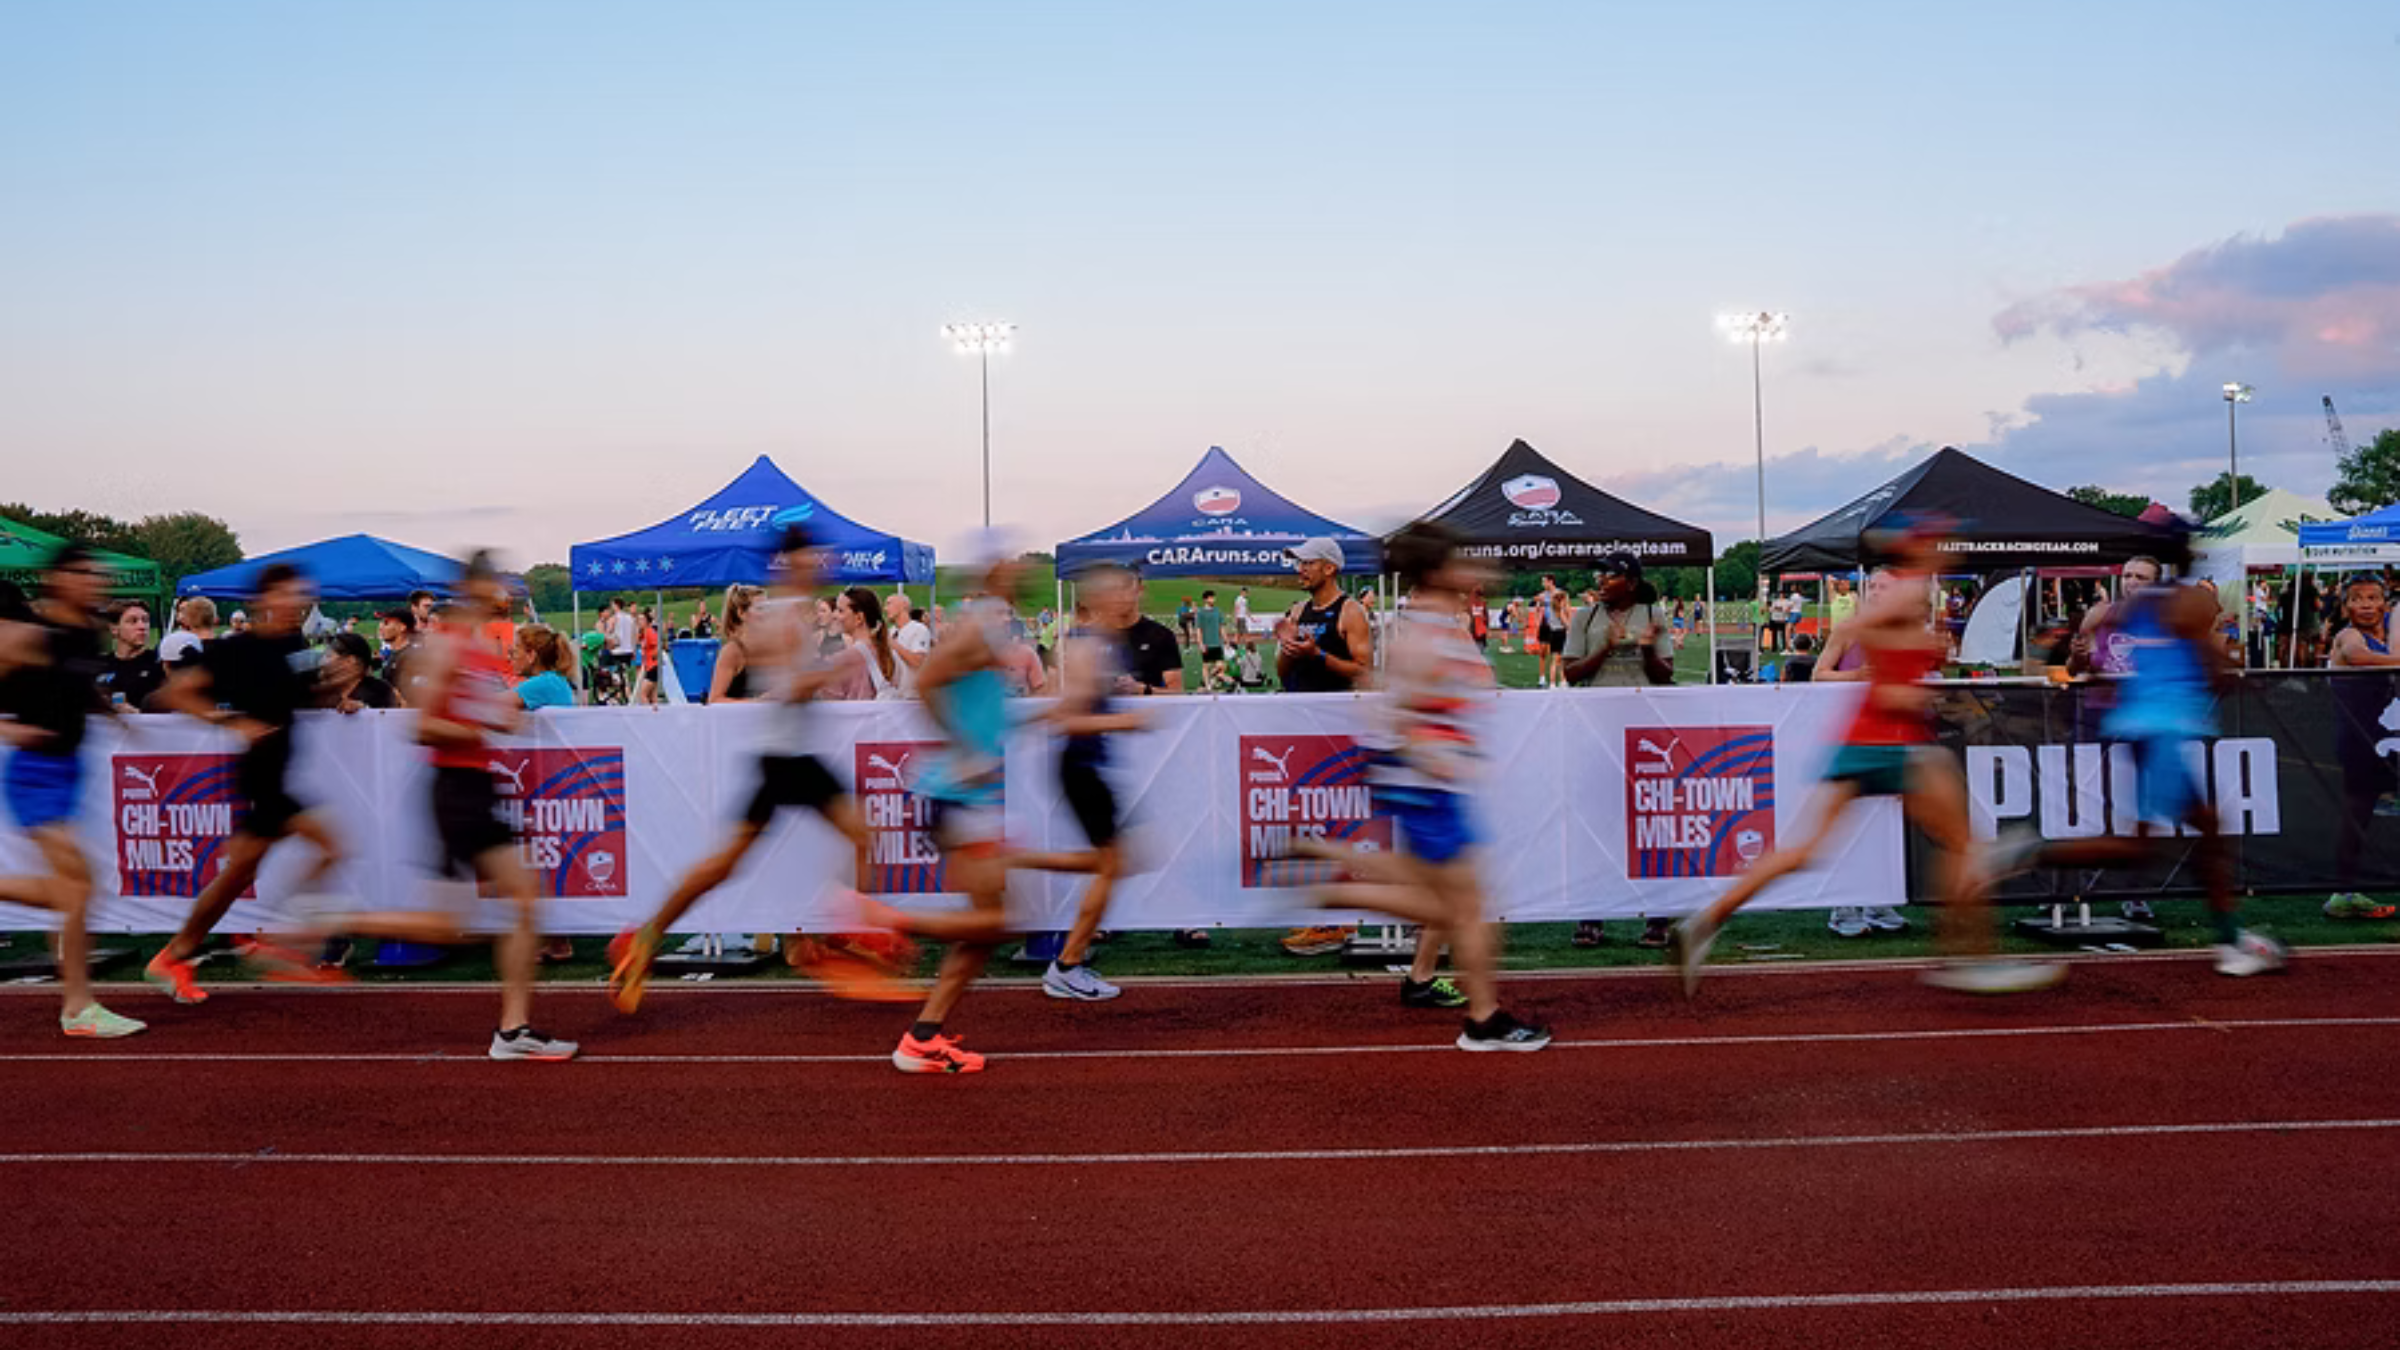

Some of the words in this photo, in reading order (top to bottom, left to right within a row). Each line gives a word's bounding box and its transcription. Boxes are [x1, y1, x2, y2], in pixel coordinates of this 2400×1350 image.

[689, 505, 778, 524] FLEET
[1457, 540, 1687, 559] runs.org/cararacingteam
[1250, 785, 1371, 821] CHI-TOWN
[1635, 777, 1754, 811] CHI-TOWN
[122, 803, 231, 837] CHI-TOWN
[490, 798, 605, 833] HI-TOWN
[1635, 814, 1711, 849] MILES
[125, 838, 194, 870] MILES
